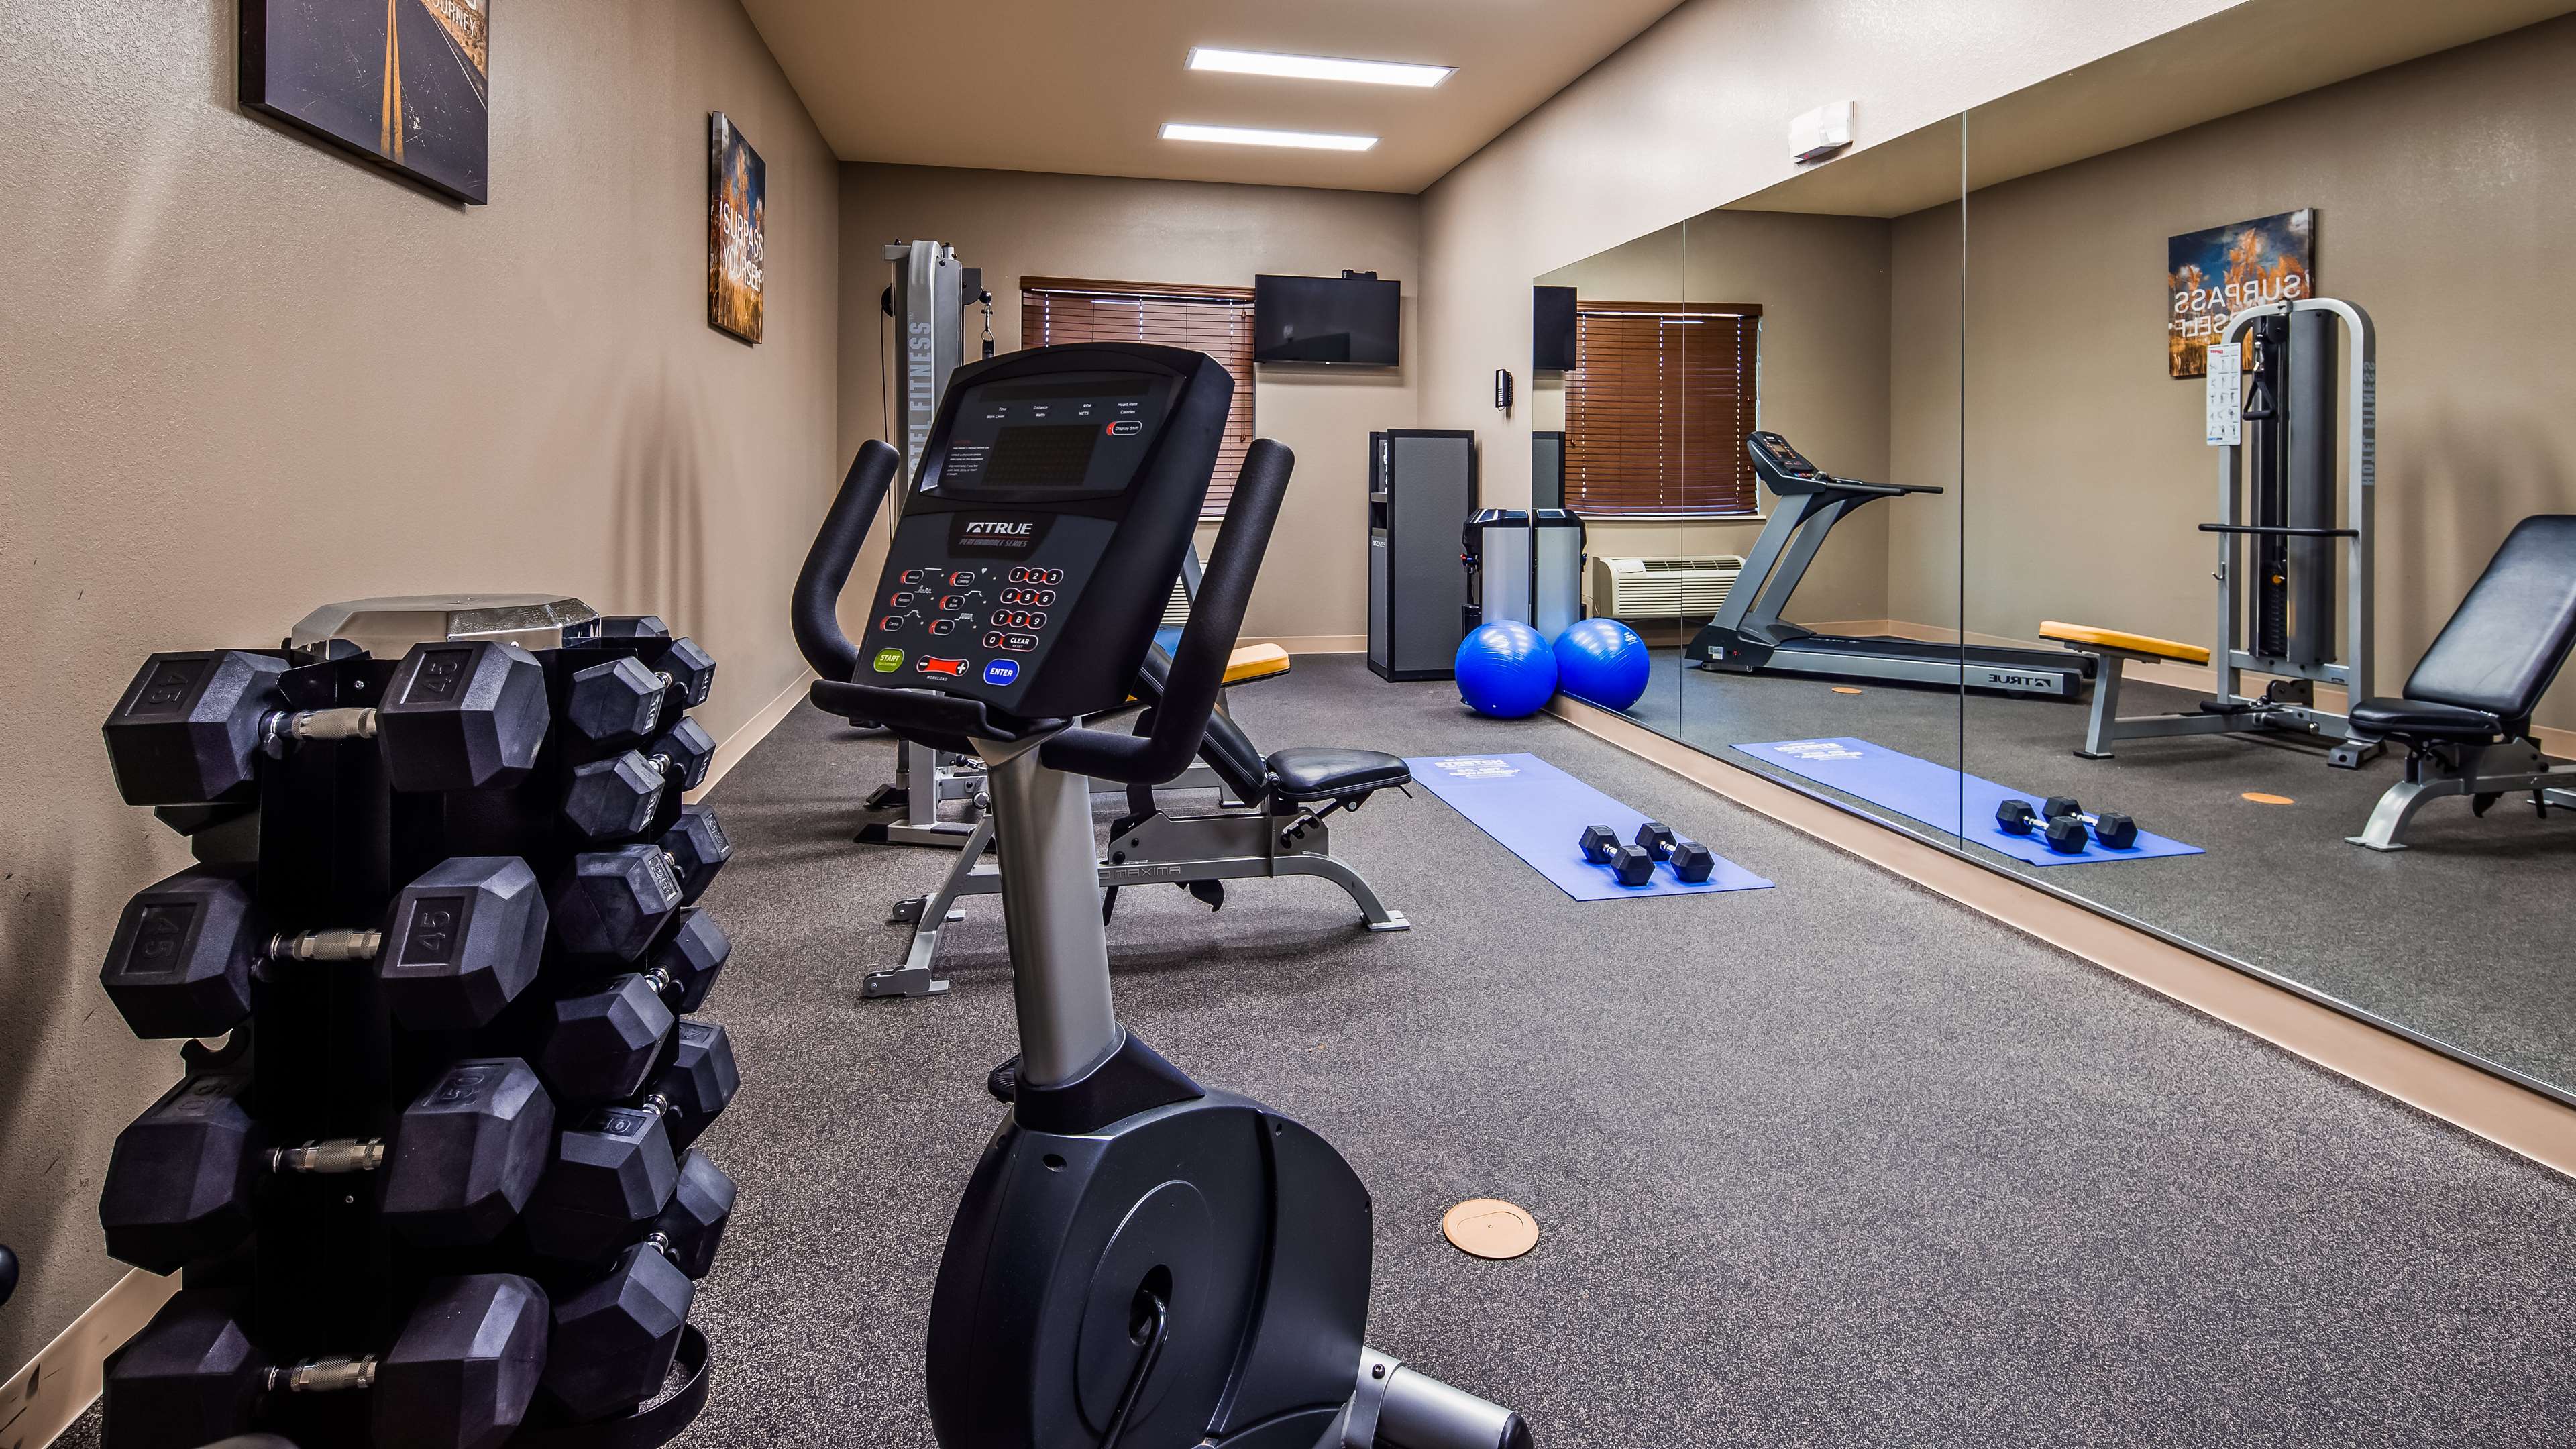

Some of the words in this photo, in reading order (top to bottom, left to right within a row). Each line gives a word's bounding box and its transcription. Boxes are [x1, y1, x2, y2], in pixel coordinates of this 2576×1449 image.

[723, 203, 763, 262] SURPASS
[723, 241, 763, 292] YOURSELF
[909, 322, 932, 411] FITNESS
[985, 522, 1033, 535] TRUE
[879, 654, 900, 663] START
[989, 667, 1014, 678] ENTER
[1114, 865, 1181, 879] MAXIMA
